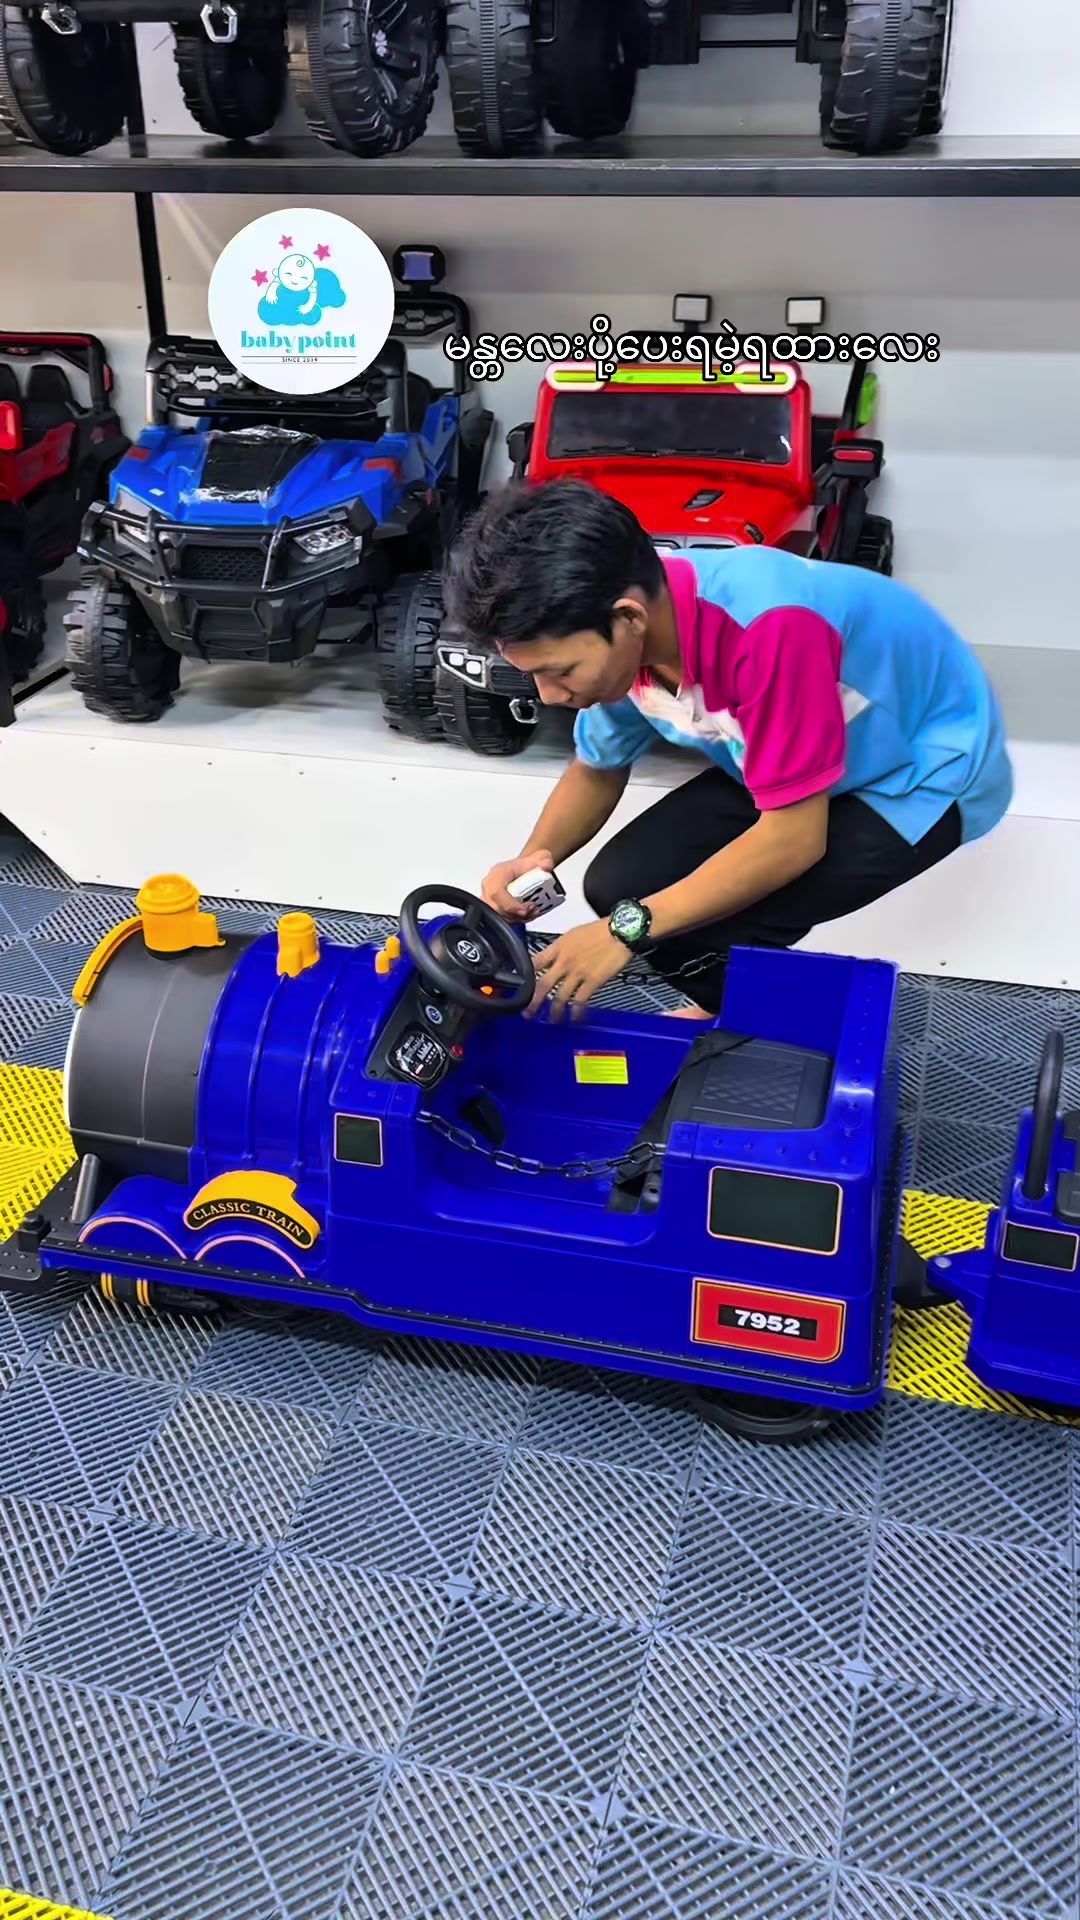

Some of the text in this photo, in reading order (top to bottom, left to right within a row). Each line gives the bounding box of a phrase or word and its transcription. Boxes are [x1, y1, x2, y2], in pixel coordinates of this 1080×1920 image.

[192, 1202, 304, 1237] CLASSIC TRAIN
[734, 1309, 801, 1336] 7952
